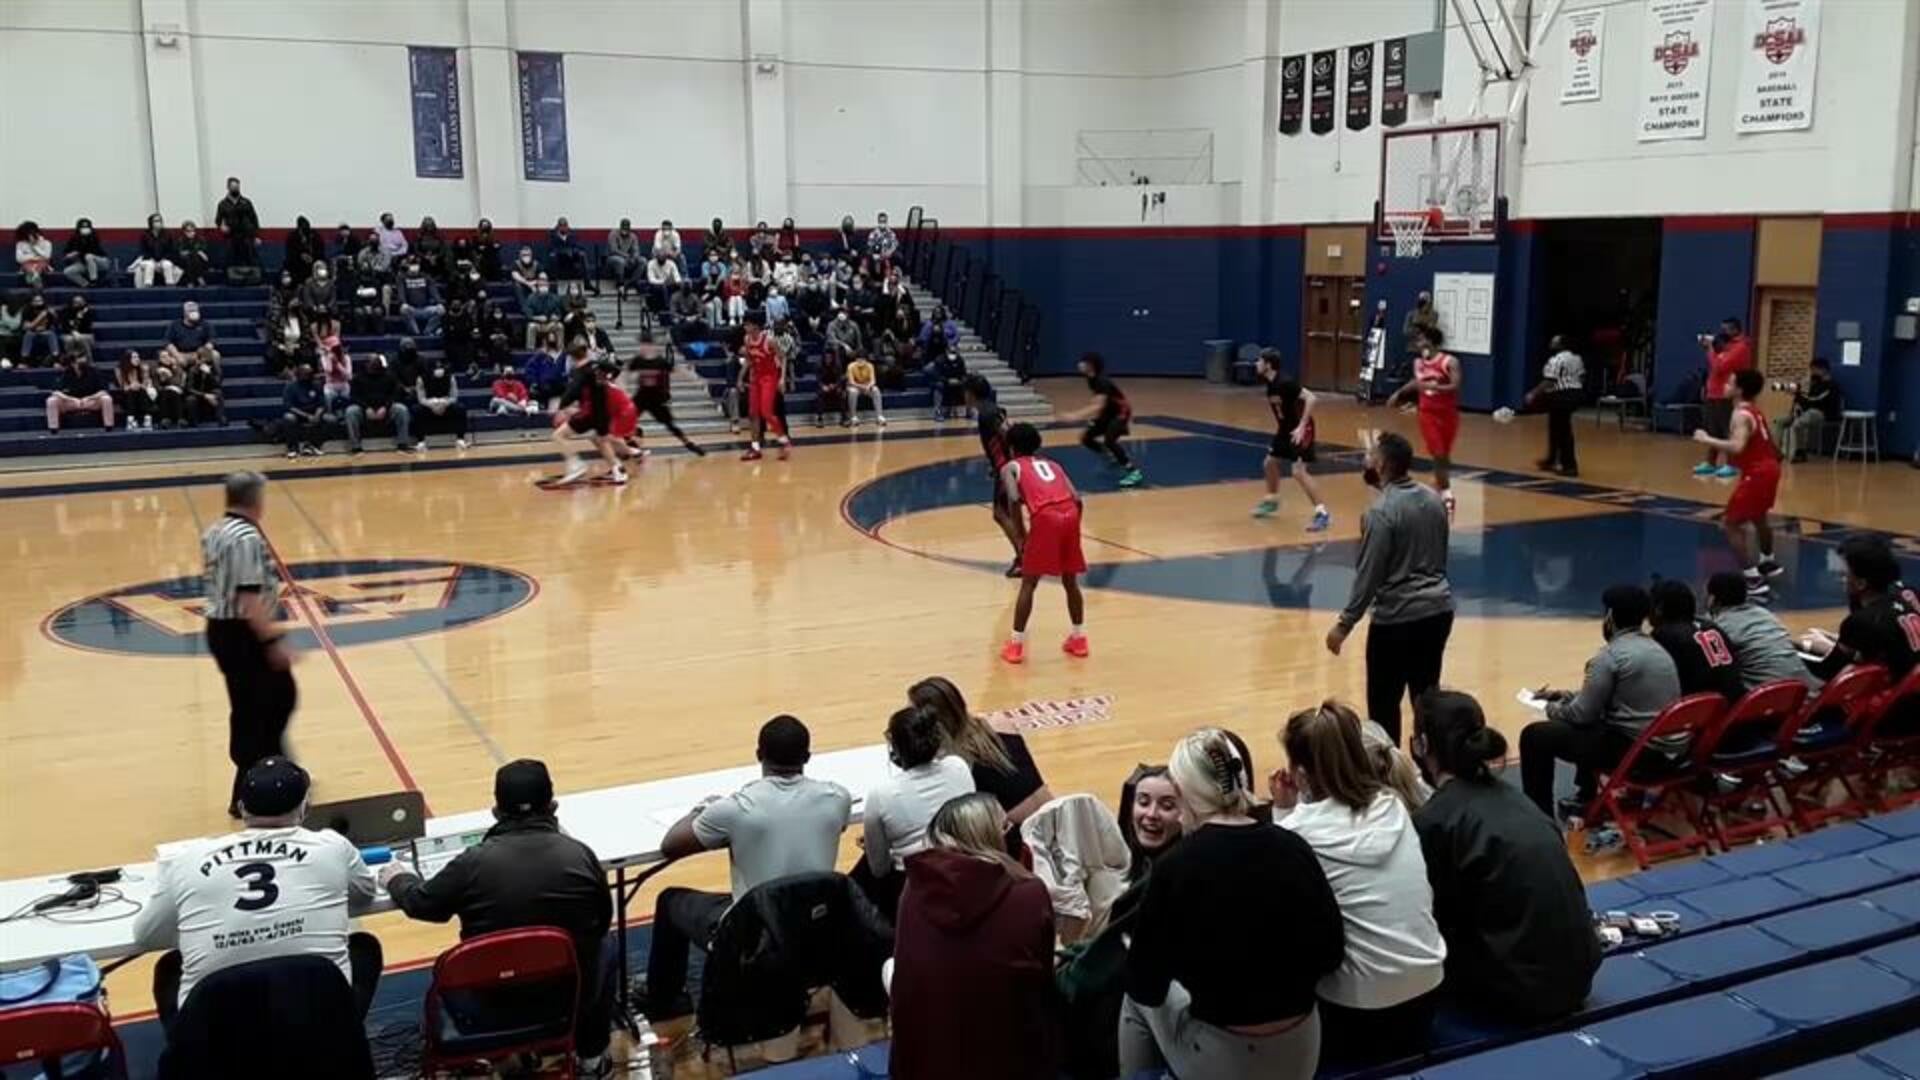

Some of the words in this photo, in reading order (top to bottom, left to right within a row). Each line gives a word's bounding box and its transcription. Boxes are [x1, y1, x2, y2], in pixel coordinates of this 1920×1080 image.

[1760, 97, 1792, 108] STATE
[1659, 106, 1688, 116] STATE
[1742, 111, 1805, 124] CHAMPIONS
[1644, 119, 1700, 131] CHAMPIONS
[1023, 454, 1036, 481] 0
[200, 841, 307, 877] PITTMAN
[233, 863, 279, 911] 3
